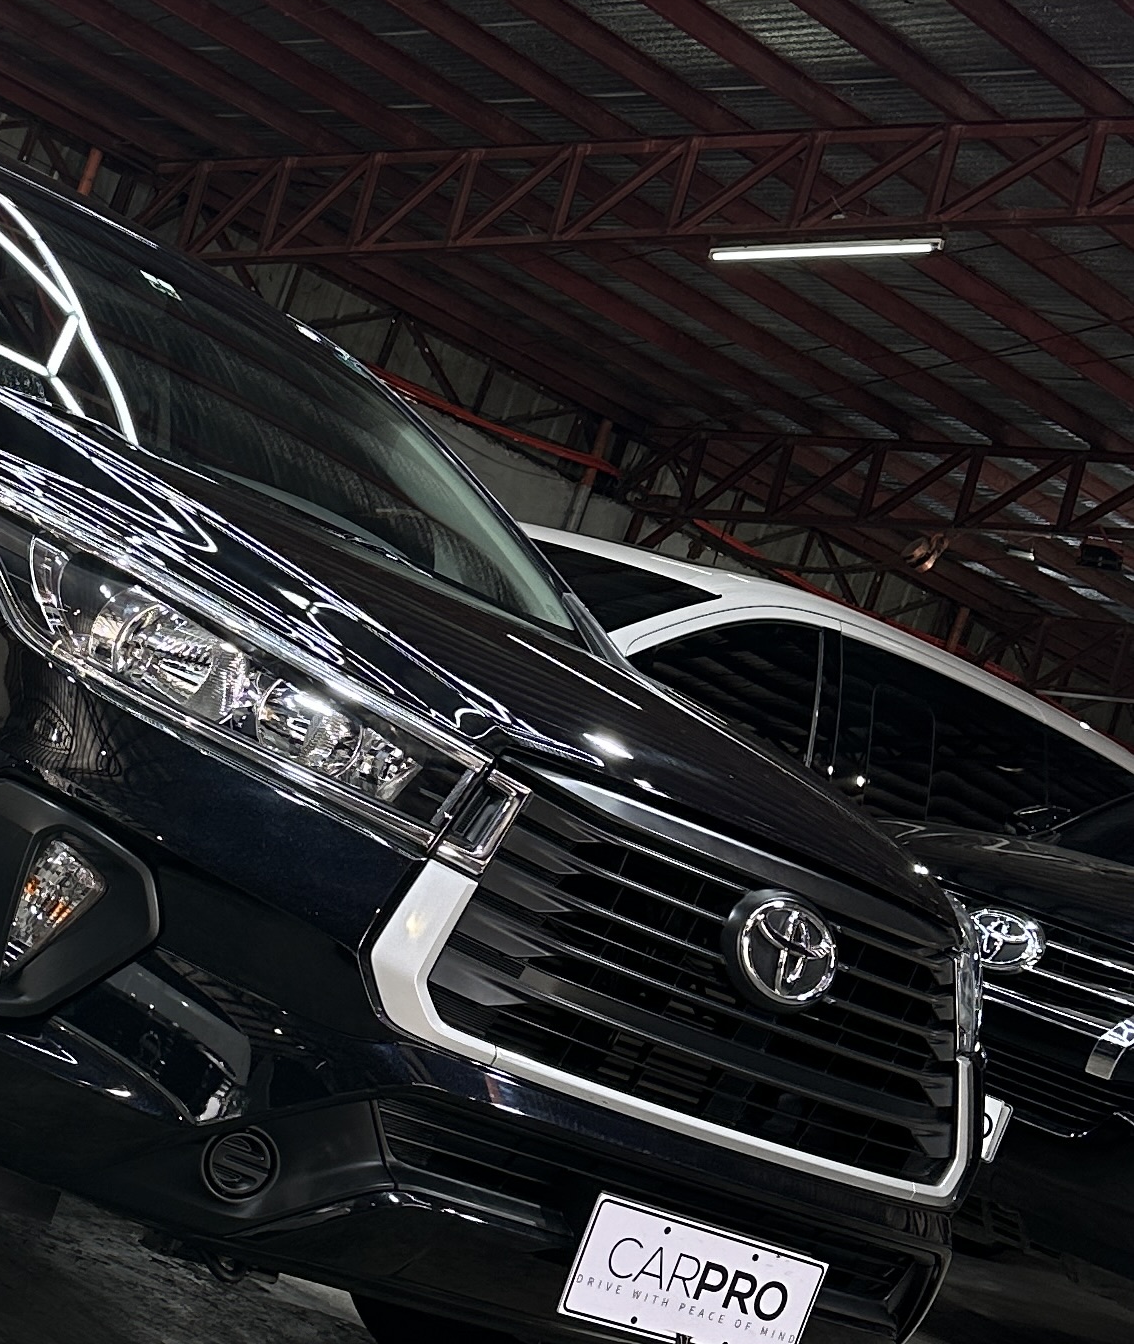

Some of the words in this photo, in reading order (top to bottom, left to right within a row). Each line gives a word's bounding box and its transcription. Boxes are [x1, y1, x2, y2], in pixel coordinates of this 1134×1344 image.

[576, 1273, 622, 1295] DRIVE
[632, 1288, 669, 1308] WITH
[678, 1302, 726, 1324] PEACE
[734, 1318, 753, 1331] OF
[760, 1326, 796, 1344] MIND
[608, 1237, 788, 1322] CARPRO
